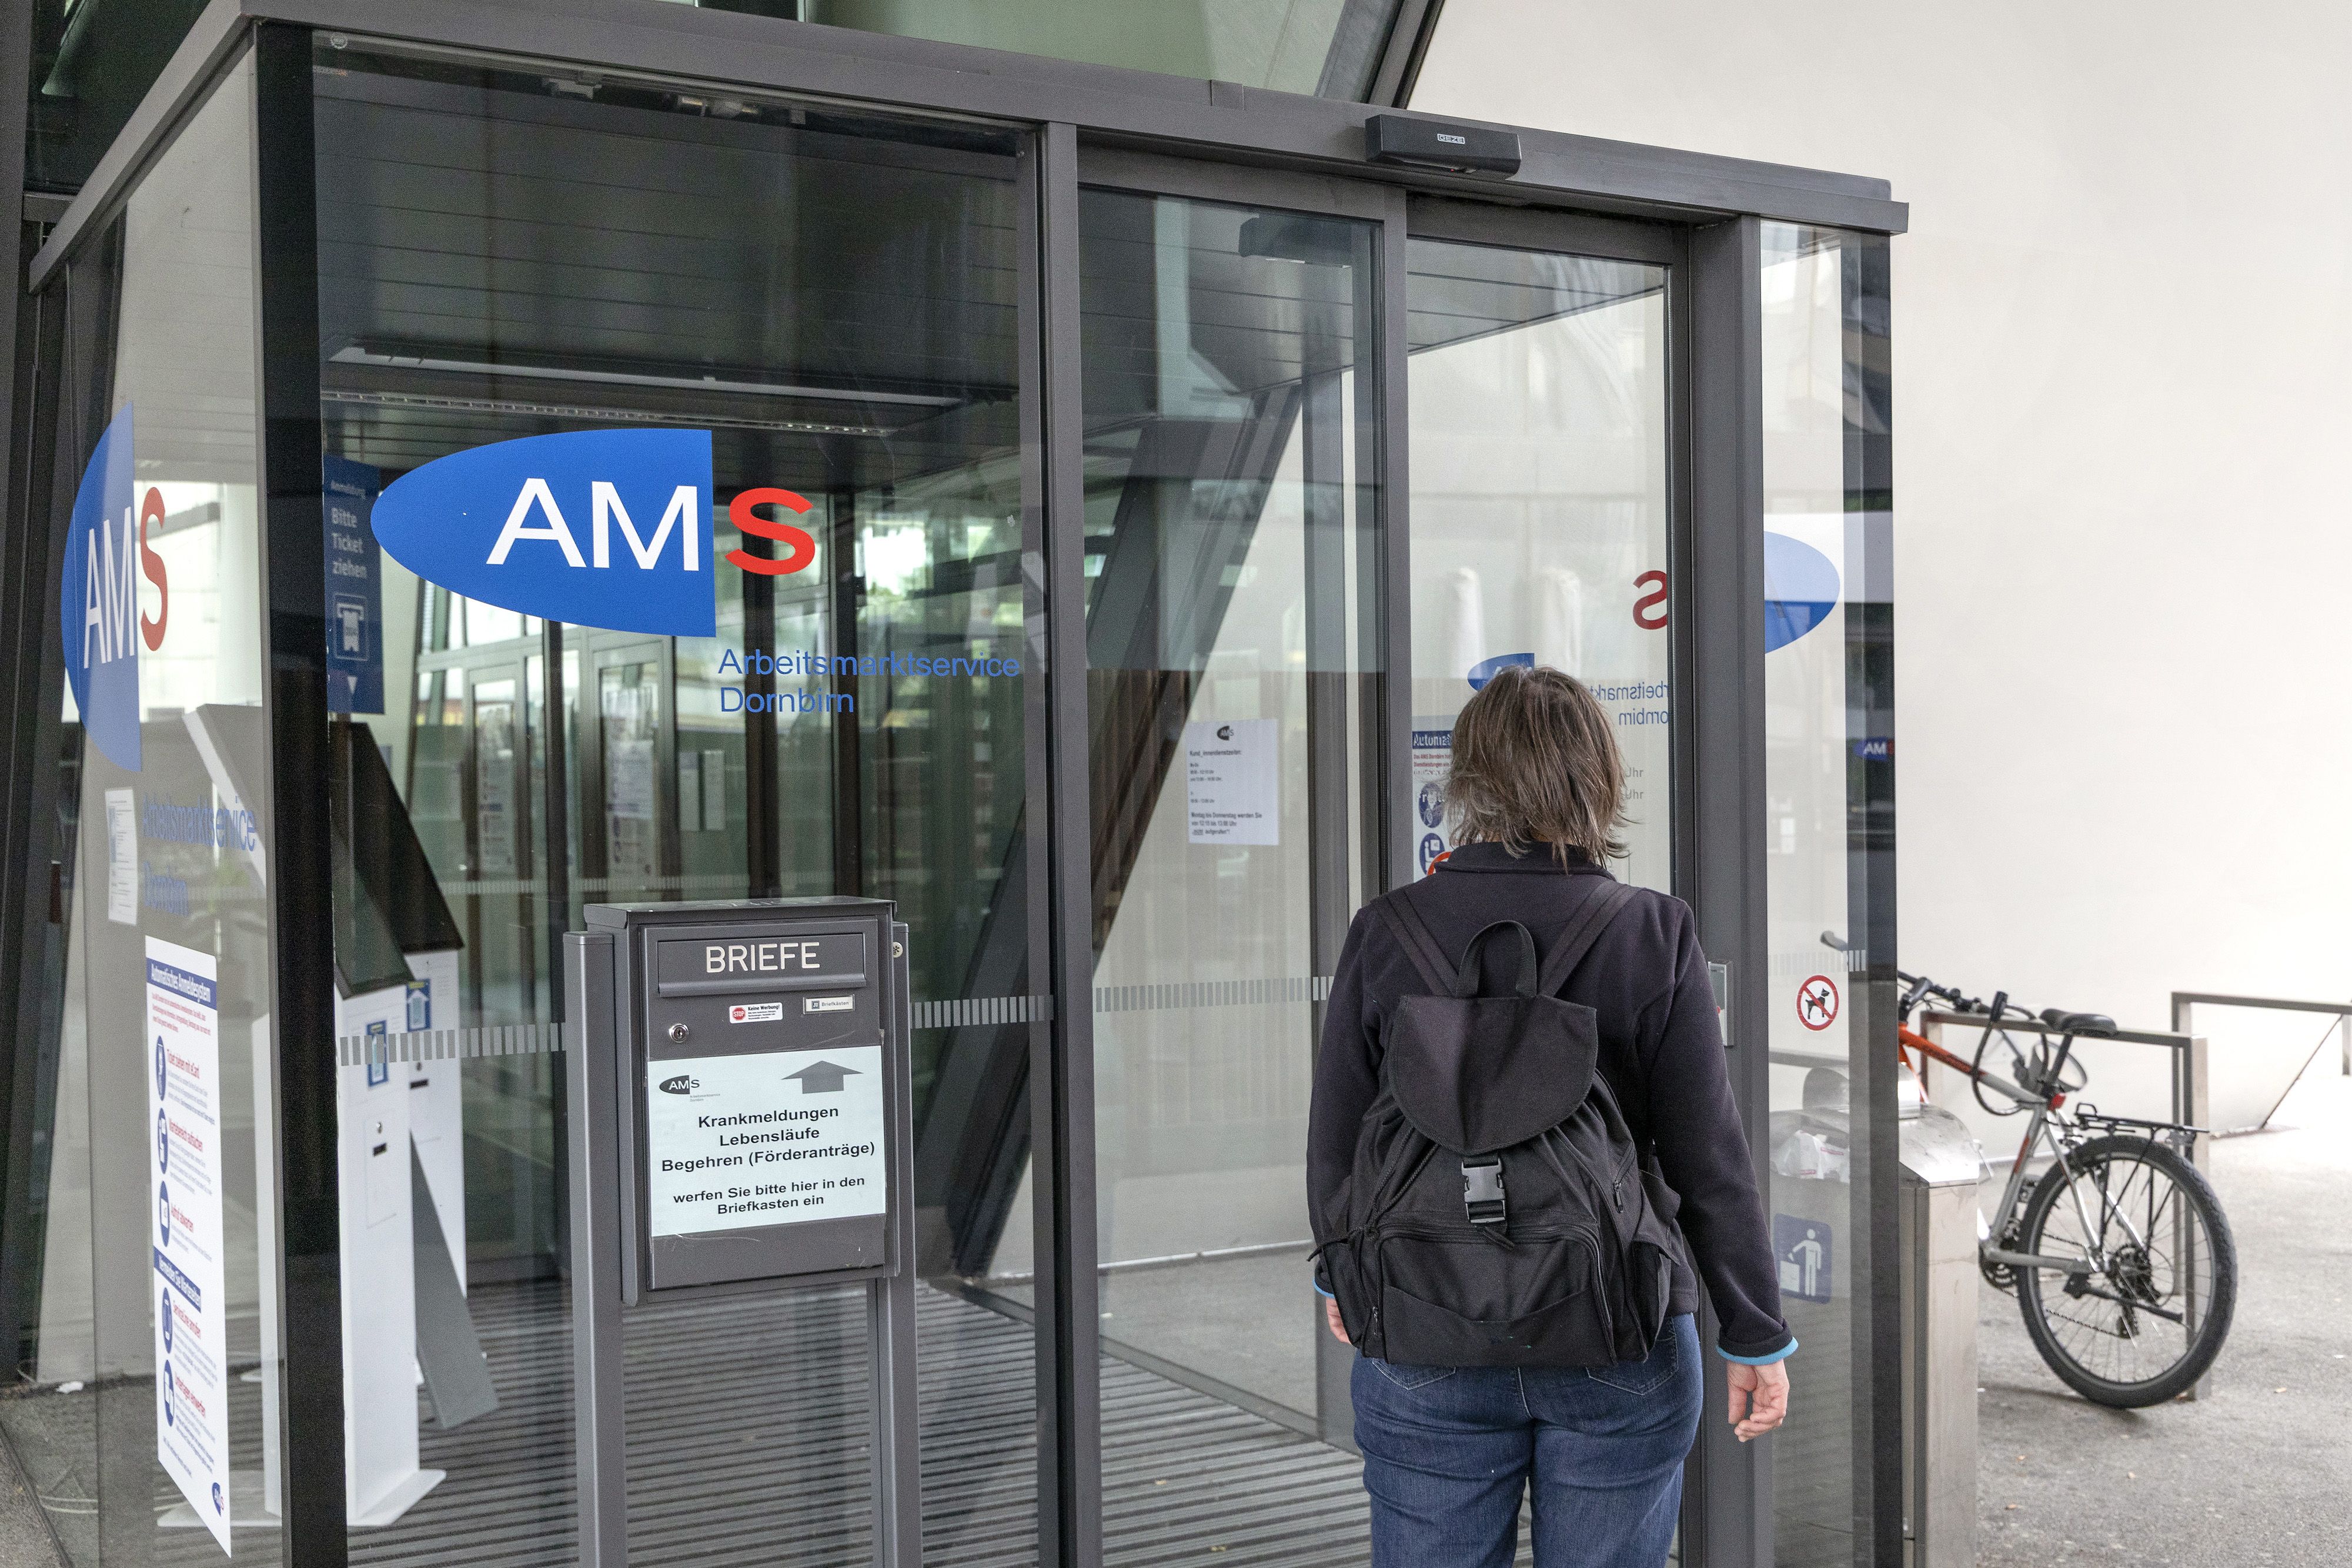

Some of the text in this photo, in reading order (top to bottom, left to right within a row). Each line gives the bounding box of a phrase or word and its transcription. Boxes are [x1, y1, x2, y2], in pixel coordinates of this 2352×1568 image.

[331, 508, 357, 527] Bitte
[486, 477, 816, 575] AMS
[332, 533, 362, 553] Ticket
[83, 486, 168, 669] AMS
[333, 558, 366, 578] ziehen
[719, 649, 1020, 677] Arbeitsmarktservice
[720, 686, 854, 713] Dornbirn
[706, 942, 821, 973] BRIEFE
[669, 1079, 700, 1091] AMS
[699, 1107, 839, 1128] Krankmeldungen
[720, 1127, 820, 1147] Lebensläufe
[662, 1142, 876, 1173] Begehren (Förderanträge)
[673, 1175, 865, 1204] werfen Sie bitte hier in den
[718, 1193, 824, 1215] Briefkasten ein
